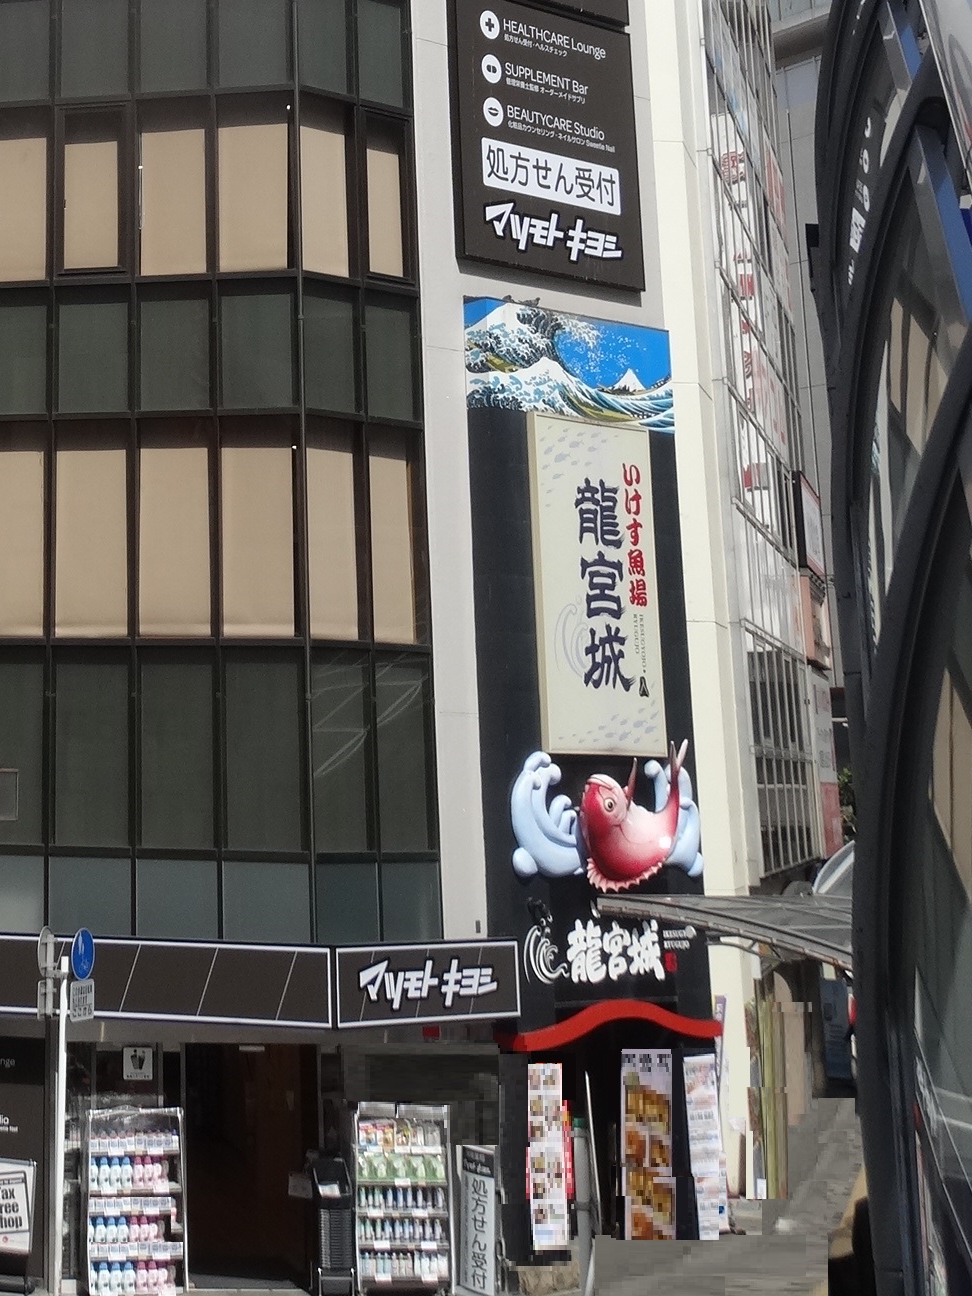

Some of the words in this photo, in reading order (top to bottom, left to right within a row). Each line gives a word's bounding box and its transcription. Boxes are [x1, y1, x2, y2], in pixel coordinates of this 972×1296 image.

[503, 18, 570, 48] HEALTHCARE
[571, 37, 607, 60] Lounge
[505, 62, 571, 90] SUPPLEMENT
[572, 80, 589, 95] Bar
[507, 105, 572, 133] BEAUTYCARE
[574, 121, 605, 141] Studio
[486, 144, 616, 207] 処方せん受付
[574, 477, 636, 692] 龍宮城
[567, 919, 666, 984] 龍宮城
[471, 1177, 488, 1290] 処方せん受付
